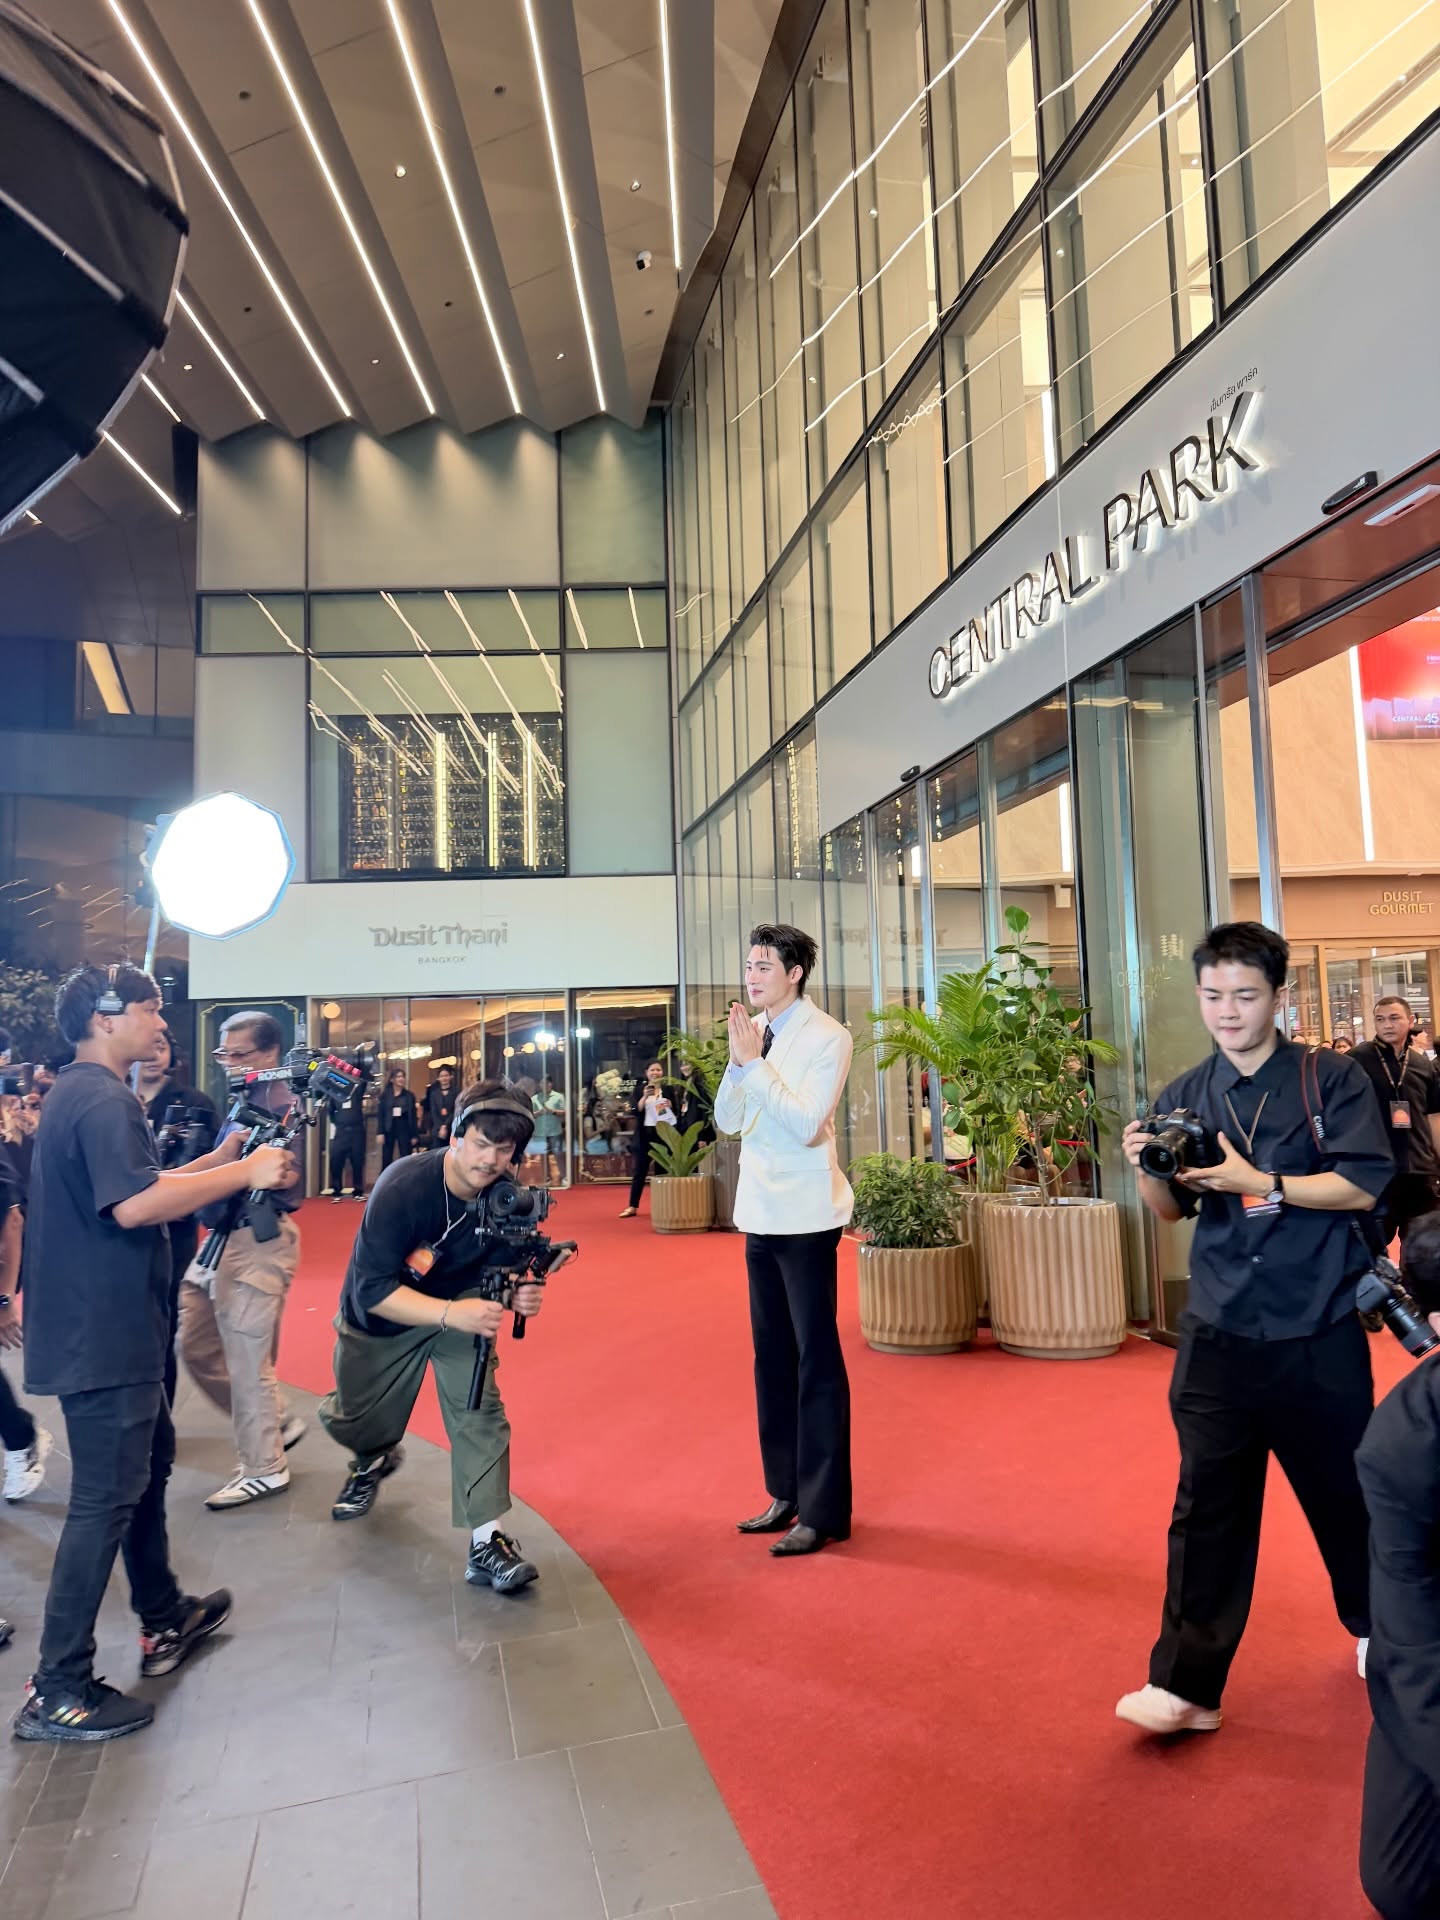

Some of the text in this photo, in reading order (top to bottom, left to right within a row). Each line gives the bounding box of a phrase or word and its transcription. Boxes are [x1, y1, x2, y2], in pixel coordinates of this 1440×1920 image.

[928, 391, 1261, 699] CENTRAL PARK
[1382, 890, 1423, 903] DUSIT
[1369, 902, 1435, 916] GOURMET
[368, 922, 508, 949] Dusit Thani
[418, 956, 467, 965] BANGKOK
